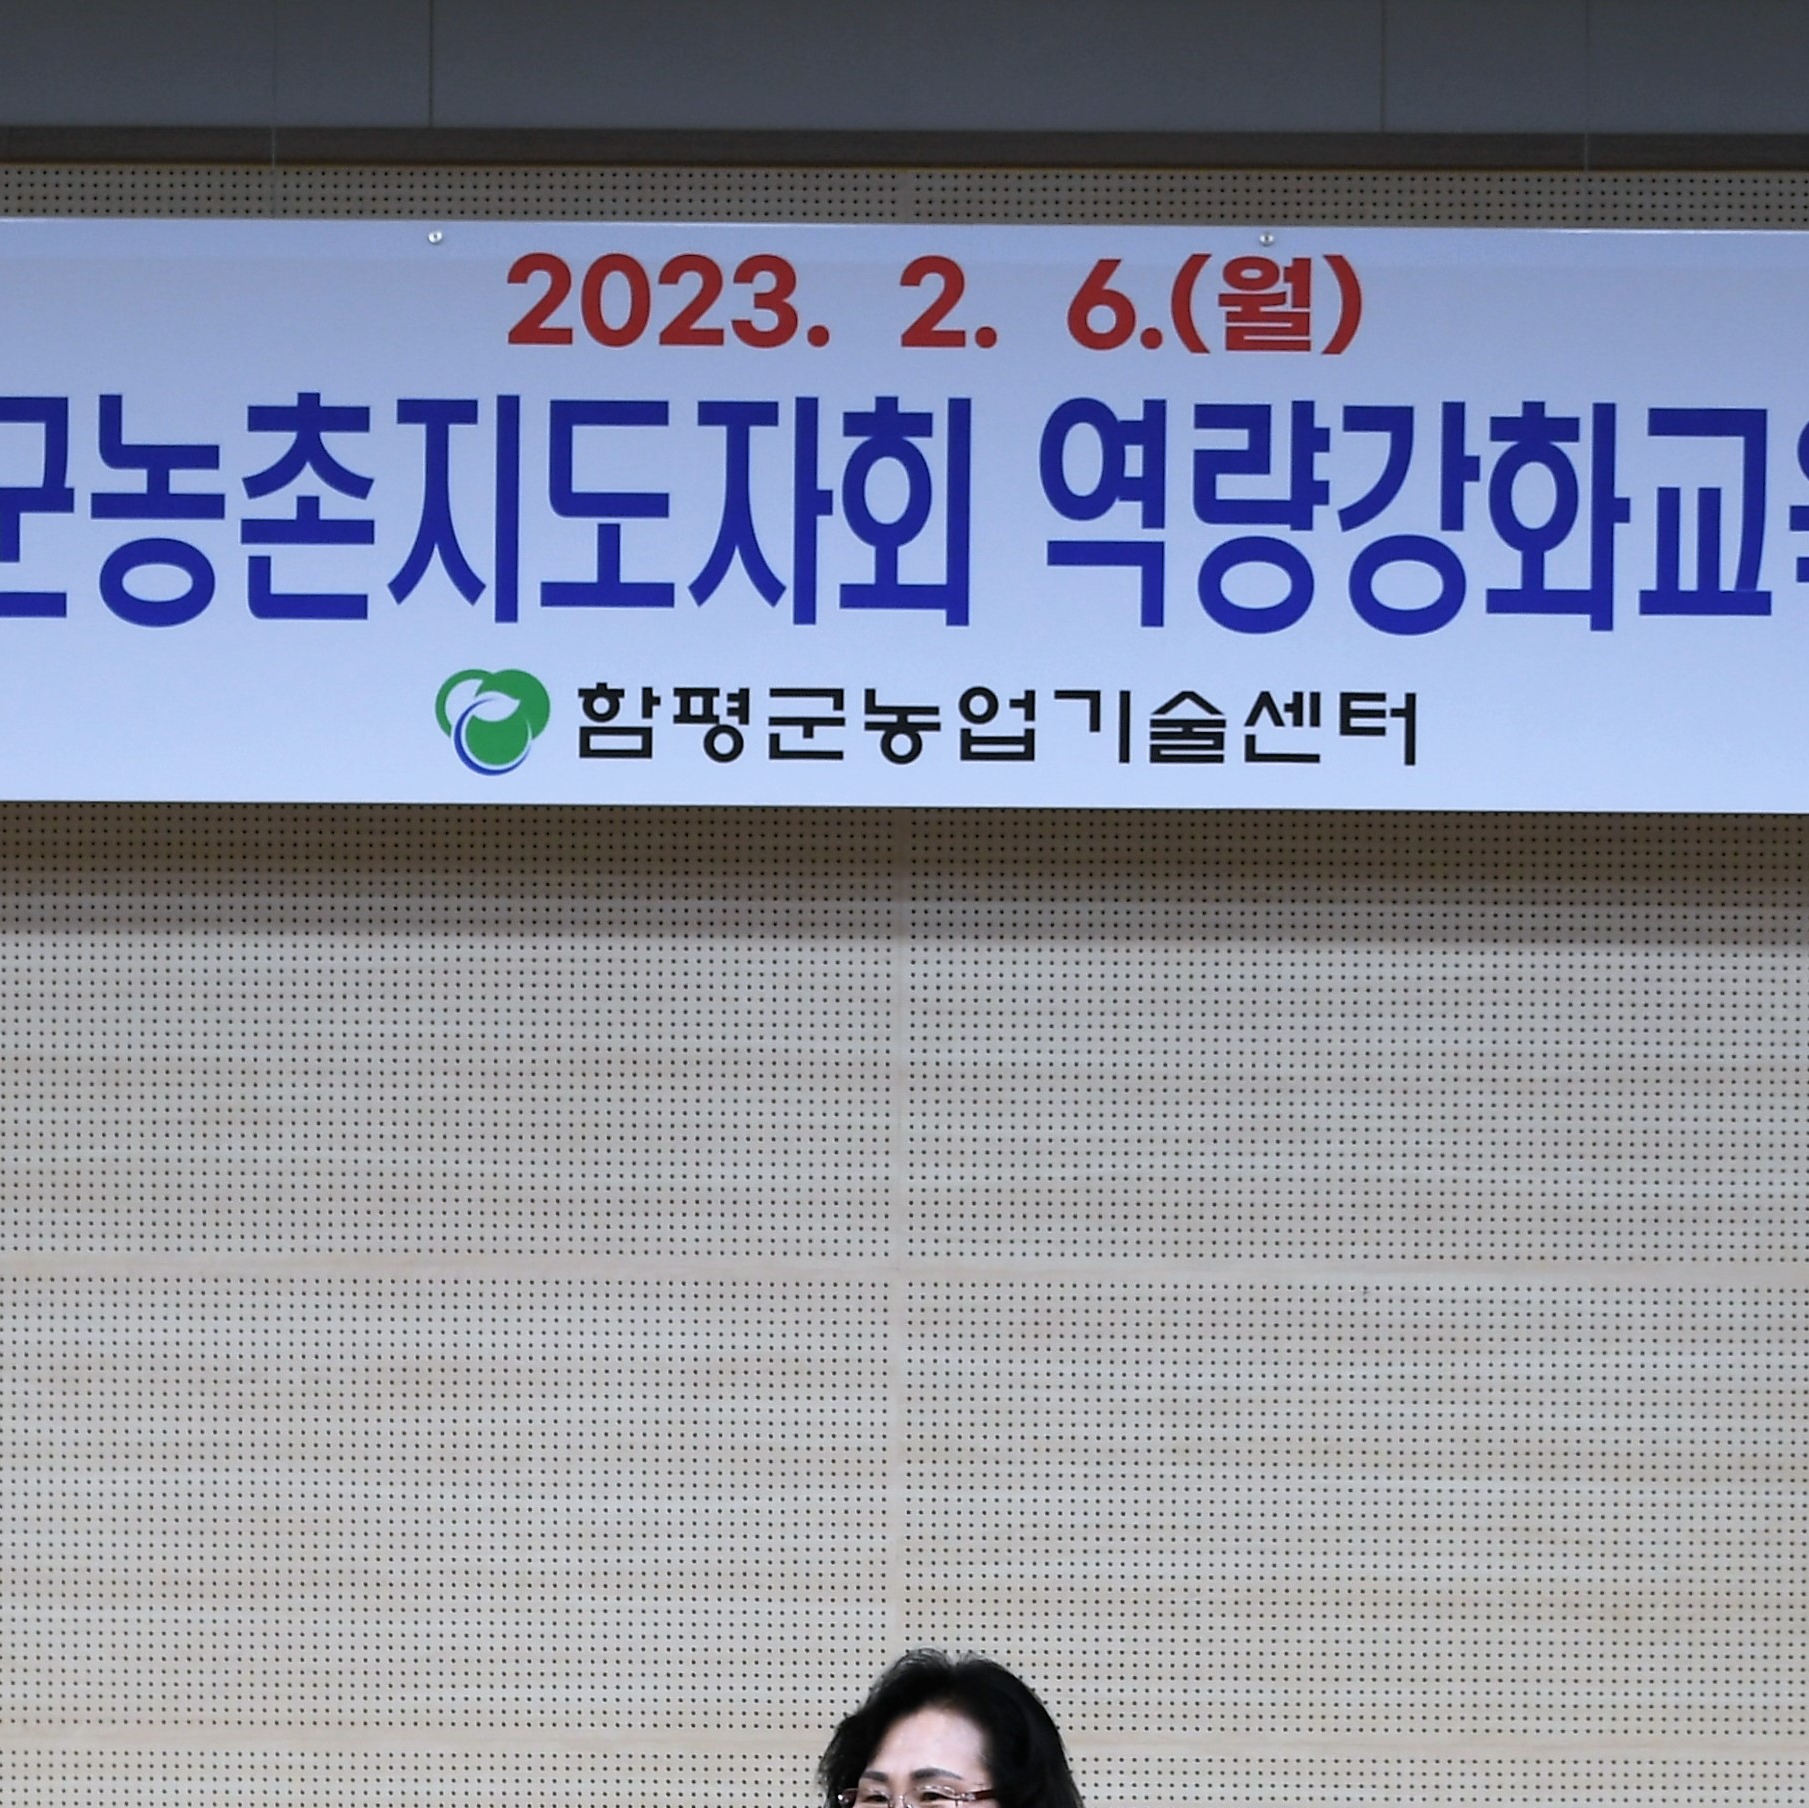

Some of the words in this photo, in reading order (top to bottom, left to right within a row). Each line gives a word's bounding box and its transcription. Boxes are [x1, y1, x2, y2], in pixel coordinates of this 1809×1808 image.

[510, 253, 830, 349] 2023.
[902, 255, 998, 348] 2.
[577, 682, 1418, 766] 함평군농업기술센터
